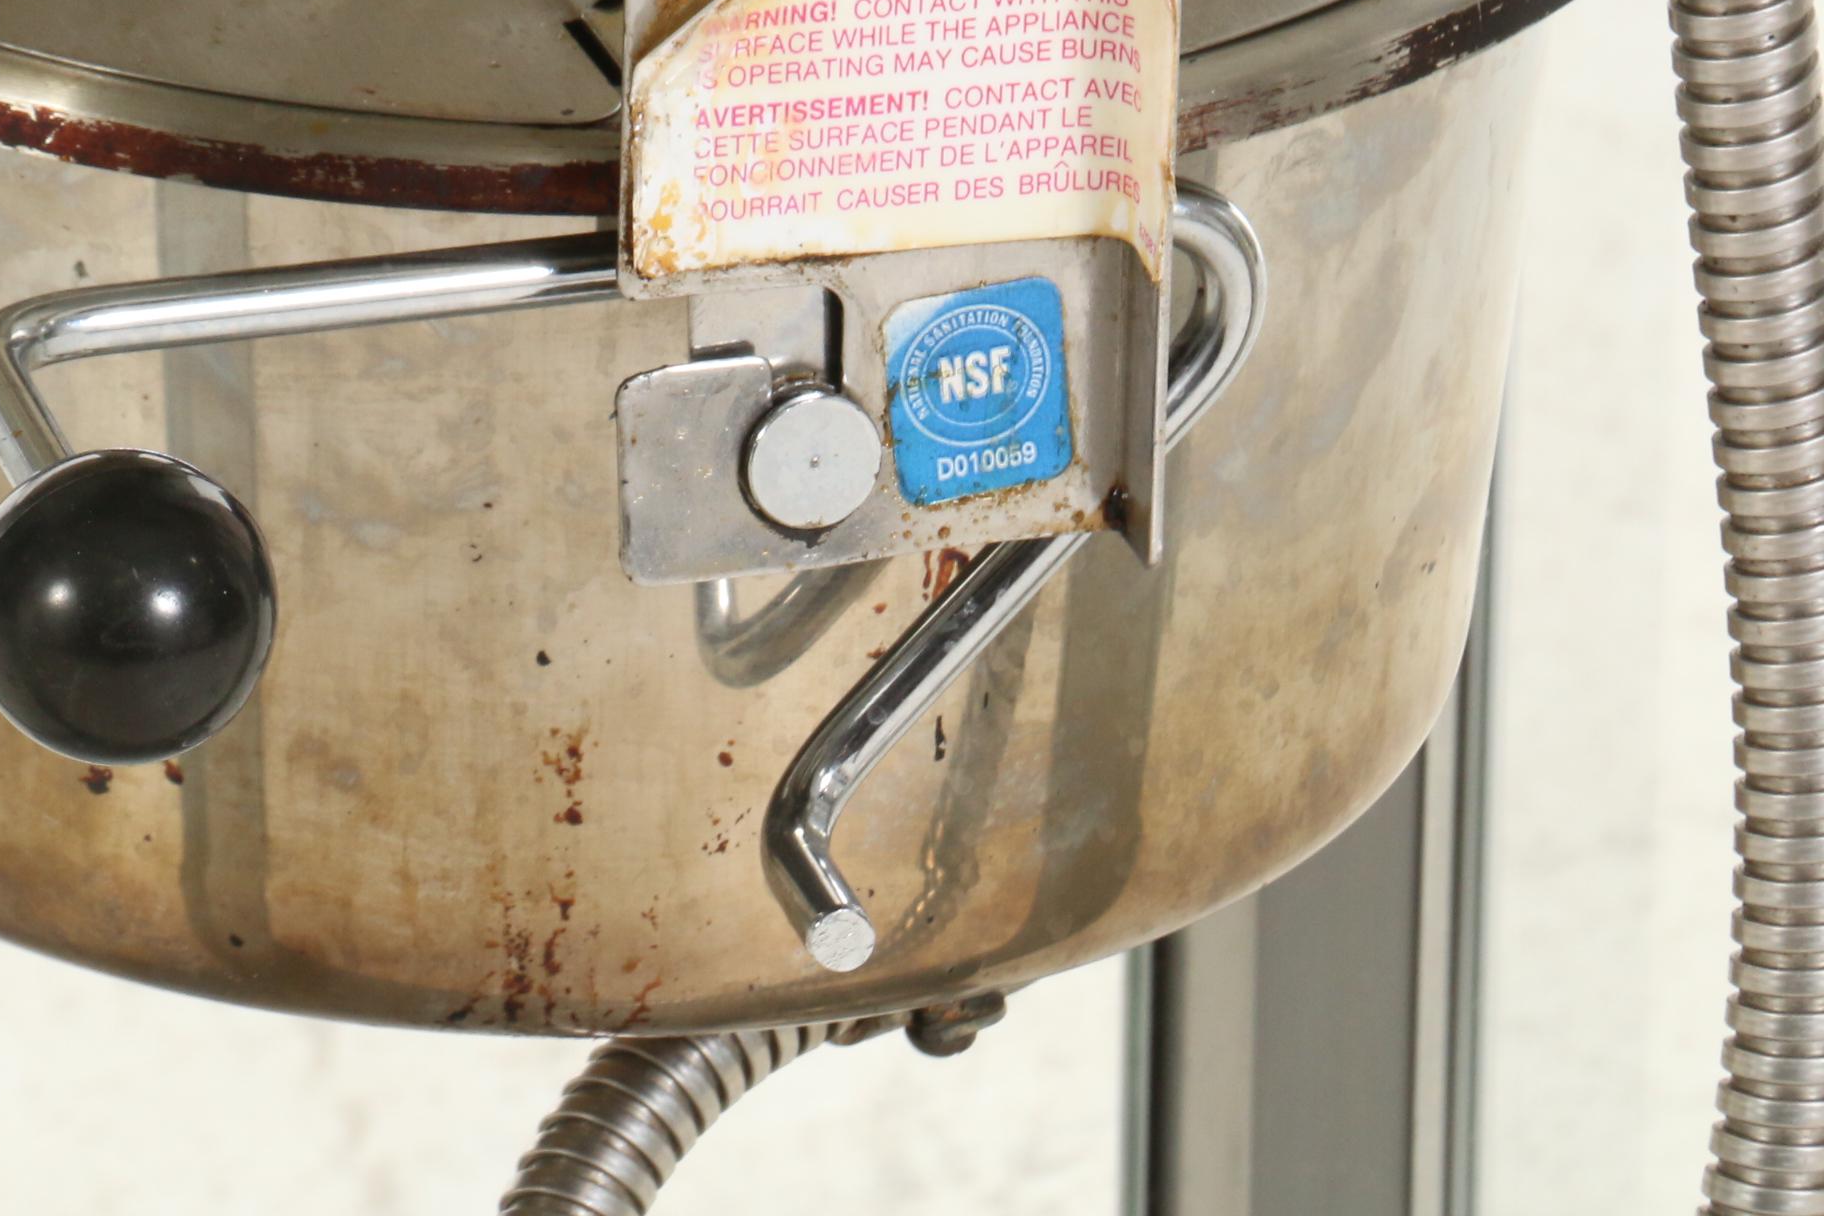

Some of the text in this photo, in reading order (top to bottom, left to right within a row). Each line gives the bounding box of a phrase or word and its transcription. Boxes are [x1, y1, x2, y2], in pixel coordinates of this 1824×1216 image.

[832, 22, 918, 50] WHILE
[924, 18, 977, 42] THE
[984, 9, 1136, 39] APPLIANCE
[727, 50, 885, 88] OPERATING
[892, 48, 953, 75] MAY
[960, 40, 1052, 69] CAUSE
[1061, 37, 1142, 74] BURNS
[694, 77, 1143, 130] AVERTISSEMENT! CONTACT AVEC
[694, 105, 1094, 160] CETTE SURFACE PENDANT LE
[938, 143, 976, 168] DE
[982, 134, 1134, 164] L'APPAREIL
[836, 181, 941, 211] CAUSER
[953, 176, 1006, 202] DES
[1018, 160, 1142, 204] BRÛLURES
[923, 309, 1010, 348] SANITATION
[936, 344, 1012, 405] NSF
[936, 440, 1038, 482] D010059
